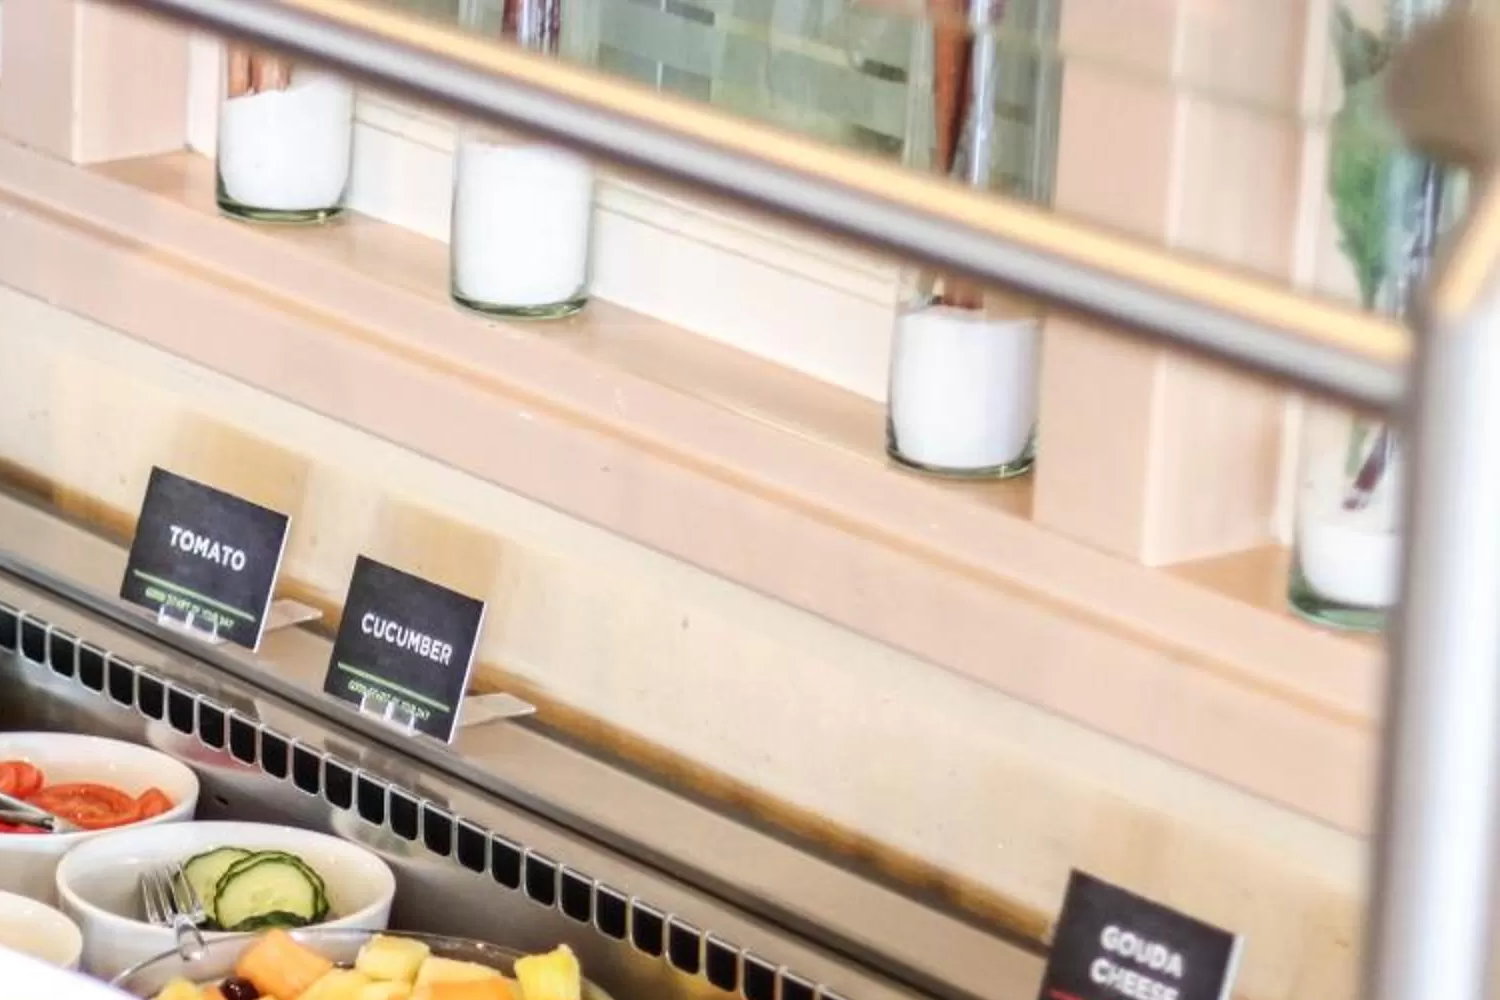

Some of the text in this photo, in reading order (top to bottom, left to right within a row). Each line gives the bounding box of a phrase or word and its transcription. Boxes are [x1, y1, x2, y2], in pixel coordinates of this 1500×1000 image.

[168, 525, 247, 572] TOMATO
[360, 612, 454, 667] CUCUMBER
[1100, 924, 1183, 979] GOUDA
